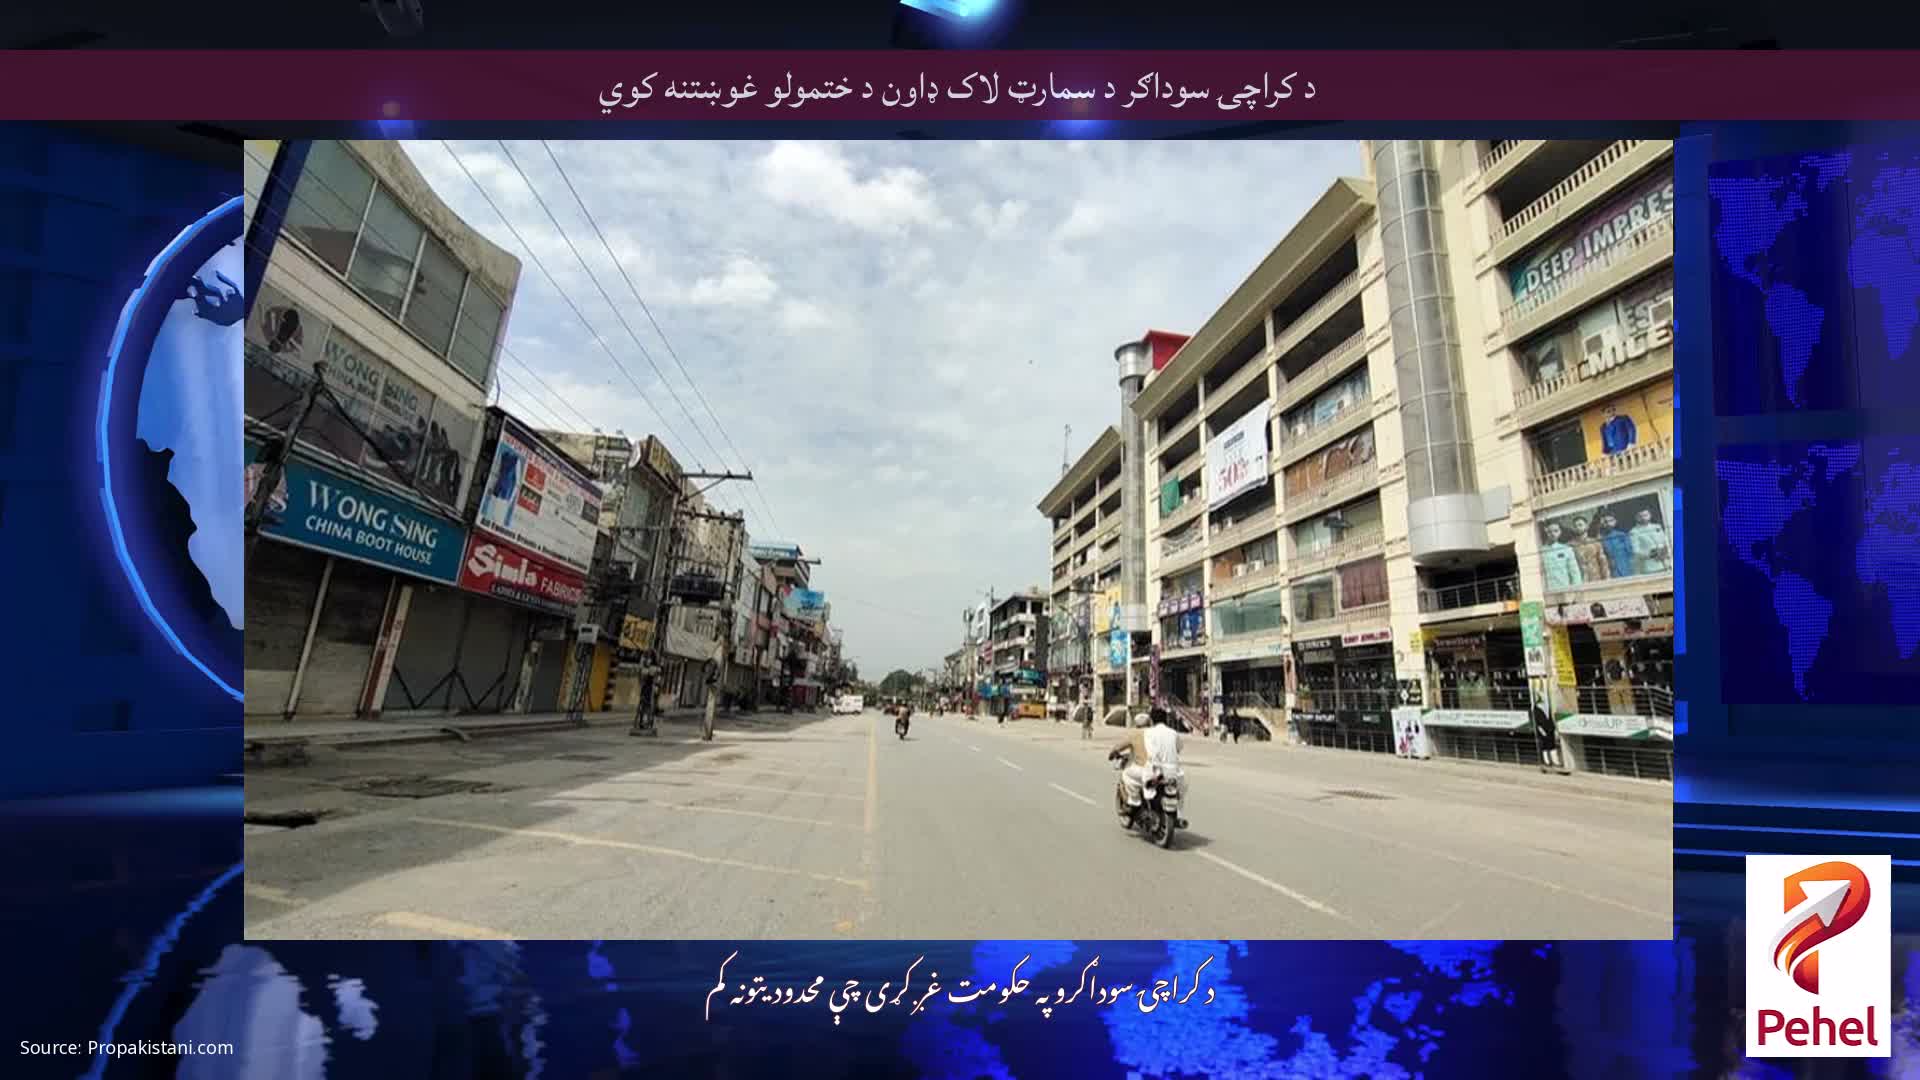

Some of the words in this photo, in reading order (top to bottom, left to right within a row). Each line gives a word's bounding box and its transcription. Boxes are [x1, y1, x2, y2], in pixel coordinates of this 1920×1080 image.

[1526, 247, 1575, 293] DEEP
[309, 480, 390, 530] WONG
[390, 514, 439, 549] SING
[305, 515, 352, 541] CHINA
[355, 530, 393, 551] BOOT
[394, 542, 432, 565] HOUSE
